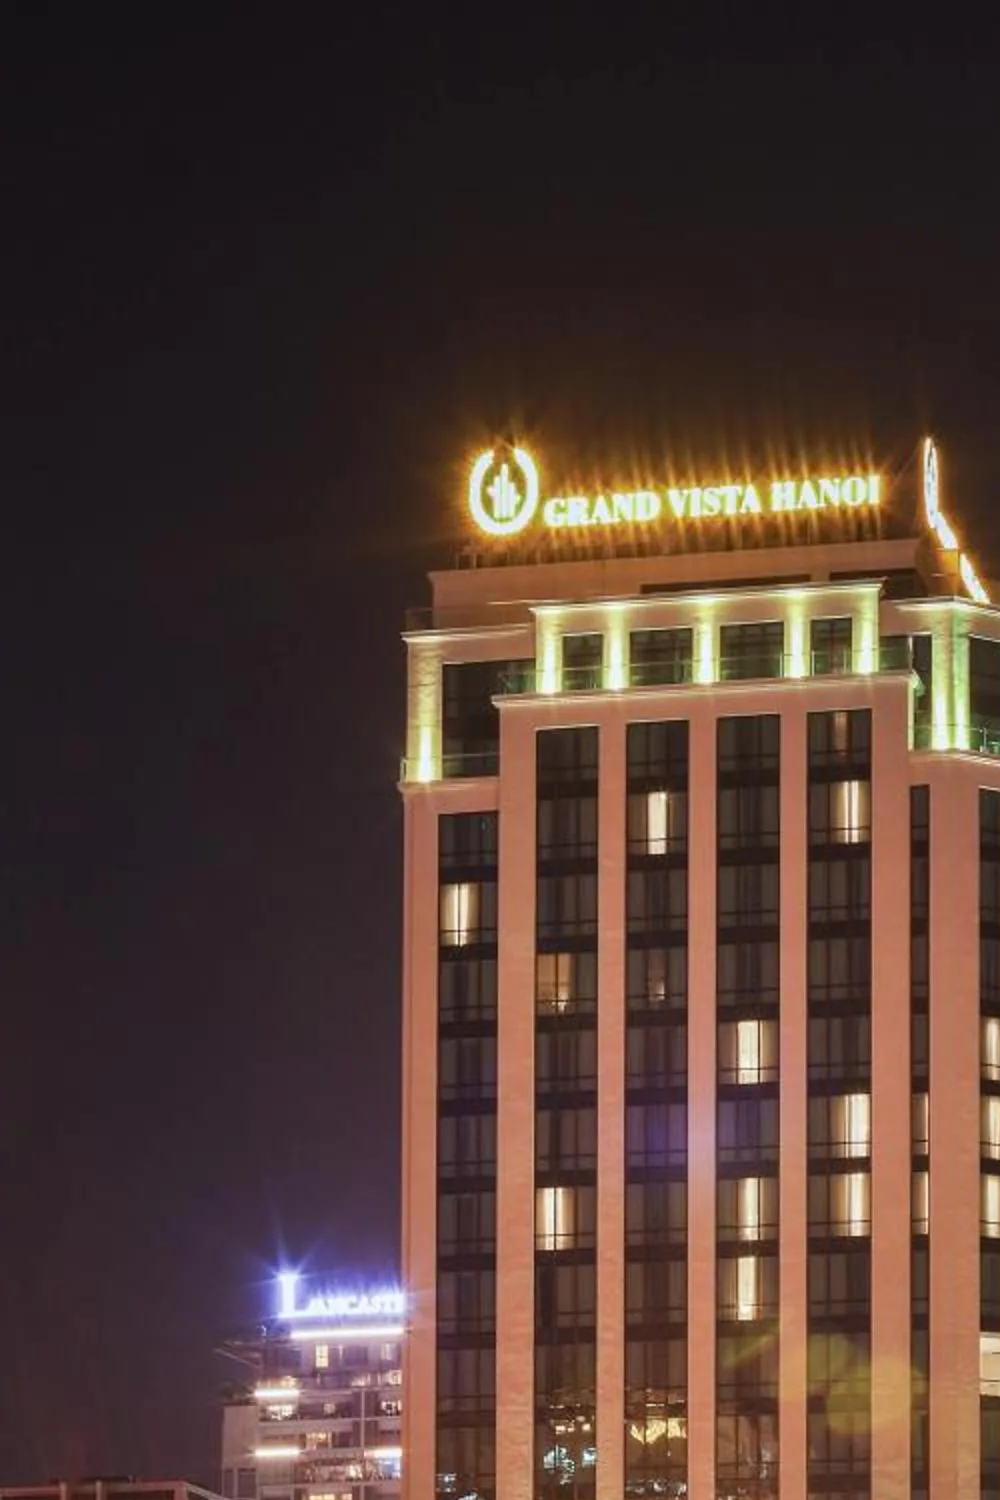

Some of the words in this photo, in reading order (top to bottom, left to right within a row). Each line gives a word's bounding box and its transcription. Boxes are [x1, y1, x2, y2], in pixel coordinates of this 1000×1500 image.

[543, 490, 661, 527] GRAND
[668, 484, 763, 518] VISTA
[772, 474, 881, 512] HANOI
